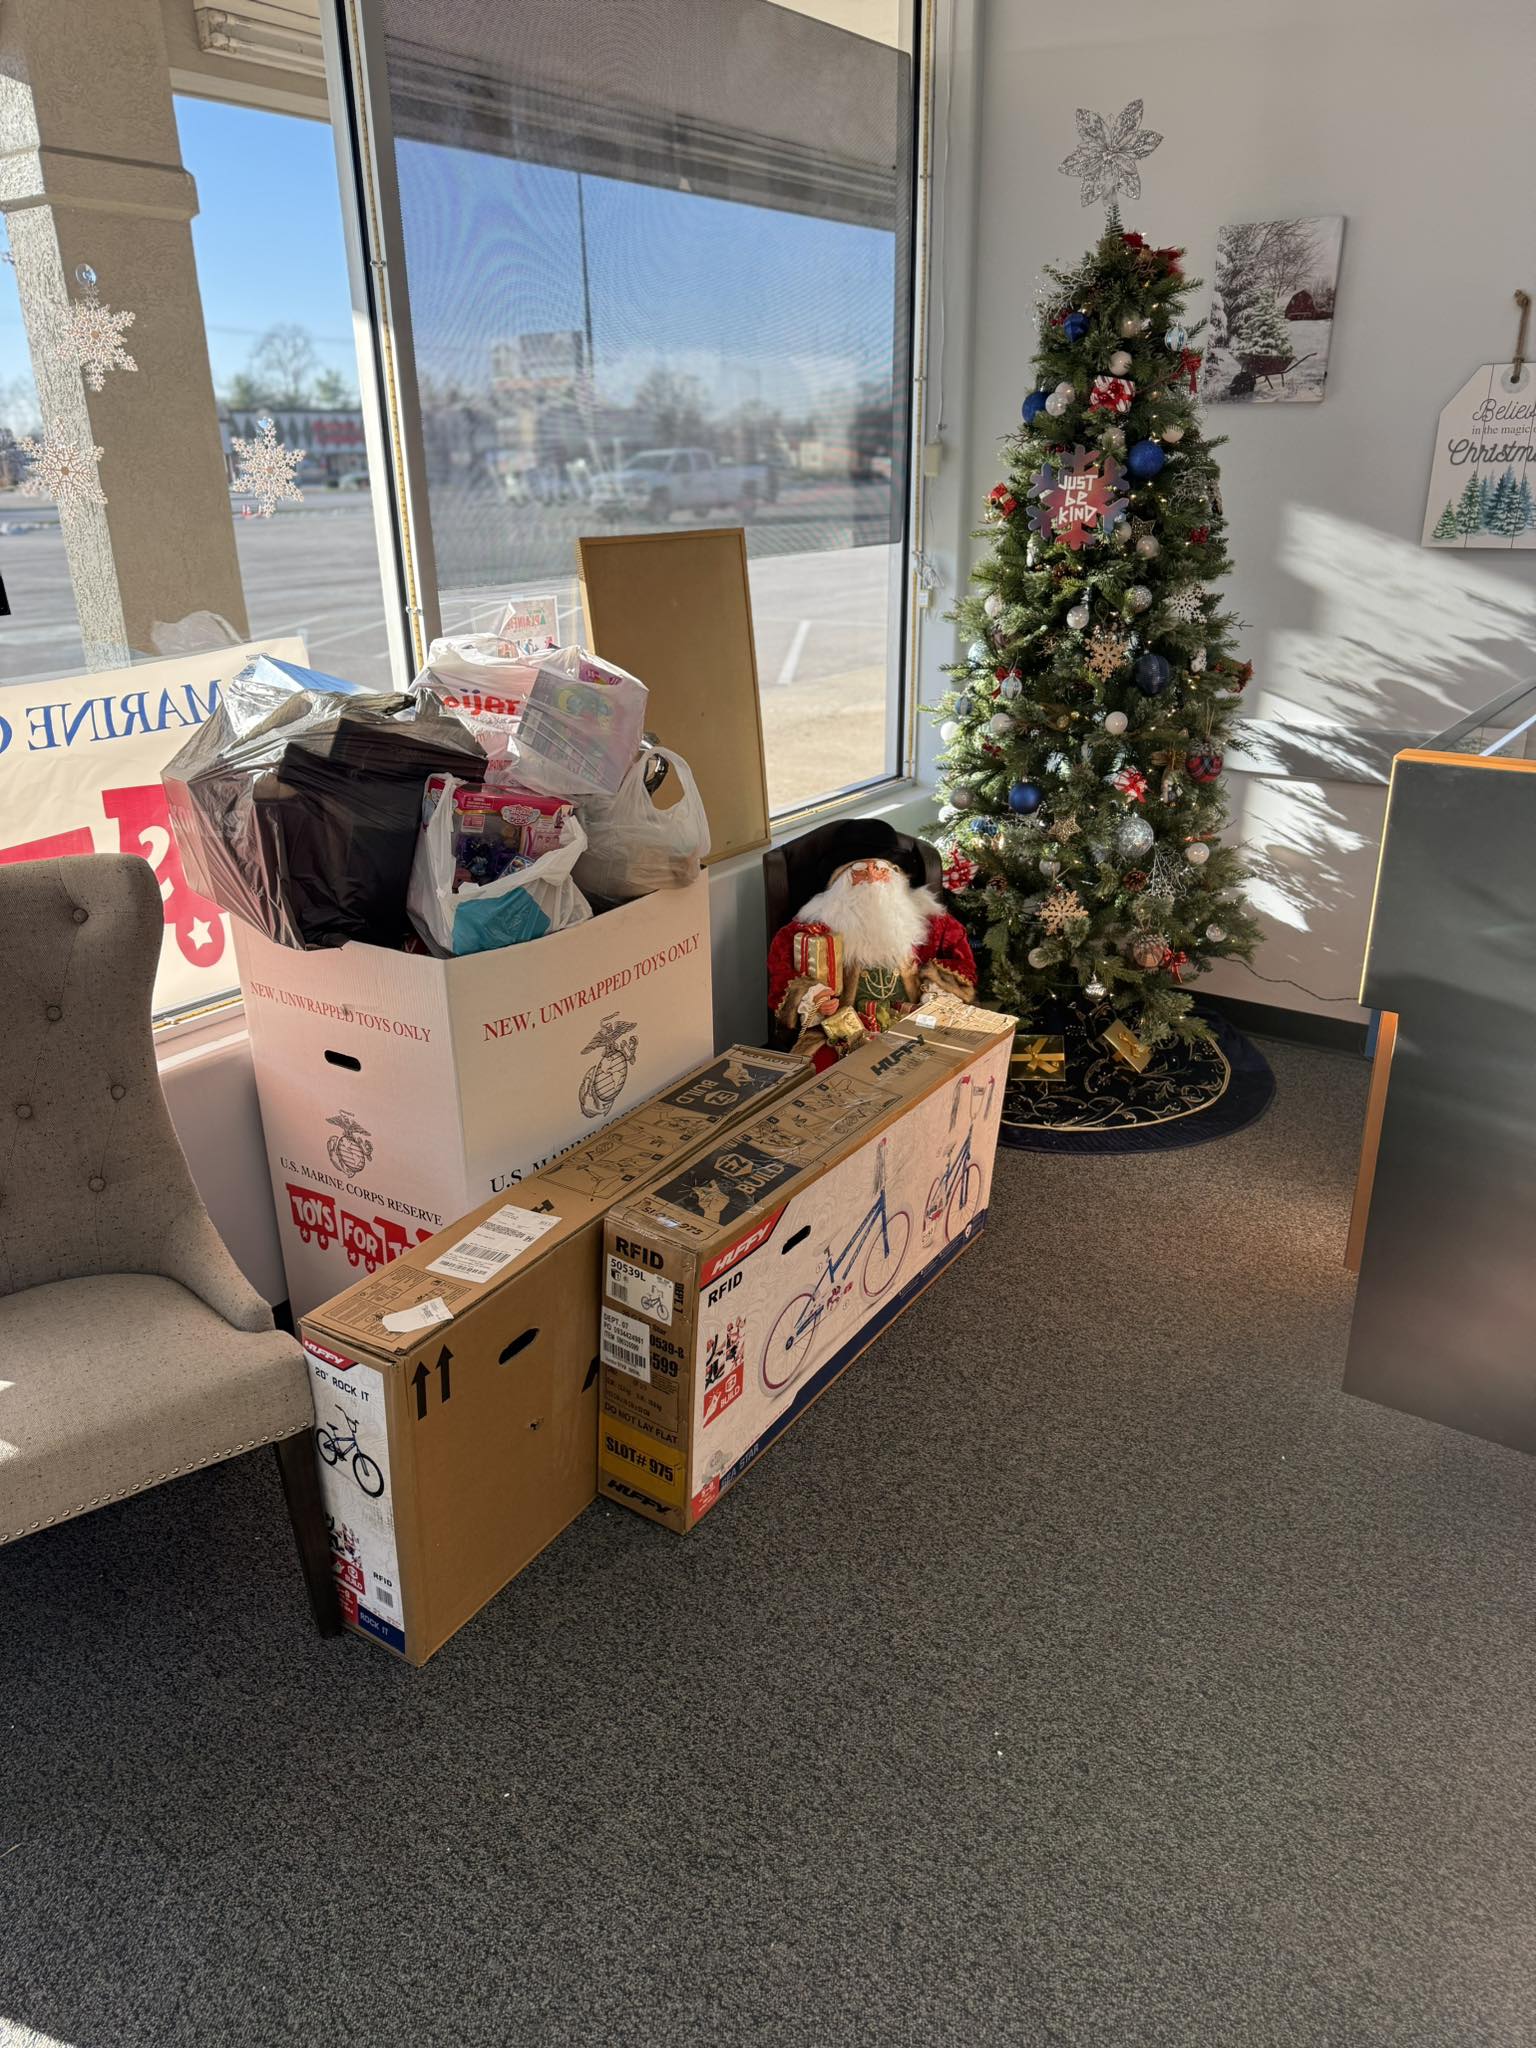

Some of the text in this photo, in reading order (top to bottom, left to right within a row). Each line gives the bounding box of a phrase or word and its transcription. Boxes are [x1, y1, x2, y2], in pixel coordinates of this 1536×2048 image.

[1472, 398, 1536, 422] Believ
[1472, 425, 1481, 435] in
[1483, 425, 1498, 434] the
[1501, 424, 1530, 435] magic
[1448, 439, 1536, 465] Christm
[1058, 474, 1098, 491] JUST
[1058, 504, 1098, 524] KIND
[443, 688, 520, 716] eijer
[482, 933, 701, 1042] NEW, UNWRAPPED TOYS ONLY
[250, 981, 431, 1043] NEW, UNWRAPPED TOYS ONLY
[870, 1033, 926, 1076] HUFFY
[280, 1157, 300, 1173] U.S.
[301, 1165, 345, 1192] MARINE
[346, 1183, 386, 1206] CORPS
[387, 1197, 444, 1226] RESERVE
[736, 1162, 785, 1196] BUILD
[292, 1195, 335, 1234] TOYS
[343, 1217, 378, 1257] FOR
[615, 1235, 664, 1270] RFID
[711, 1222, 771, 1277] HUFFY
[610, 1258, 646, 1282] 50539L
[708, 1271, 743, 1308] RFID
[303, 1340, 345, 1365] HUFFY
[650, 1352, 679, 1378] 599
[332, 1376, 358, 1397] ROCK
[360, 1391, 370, 1402] IT
[720, 1385, 741, 1409] BUILD
[605, 1402, 678, 1444] DO NOT LAY FLAT
[606, 1436, 674, 1482] SLOT# 975
[721, 1442, 760, 1488] SEA STAR
[607, 1479, 672, 1515] HUFFY
[372, 1571, 393, 1588] RFID
[360, 1611, 380, 1630] ROCK
[381, 1625, 389, 1637] IT
